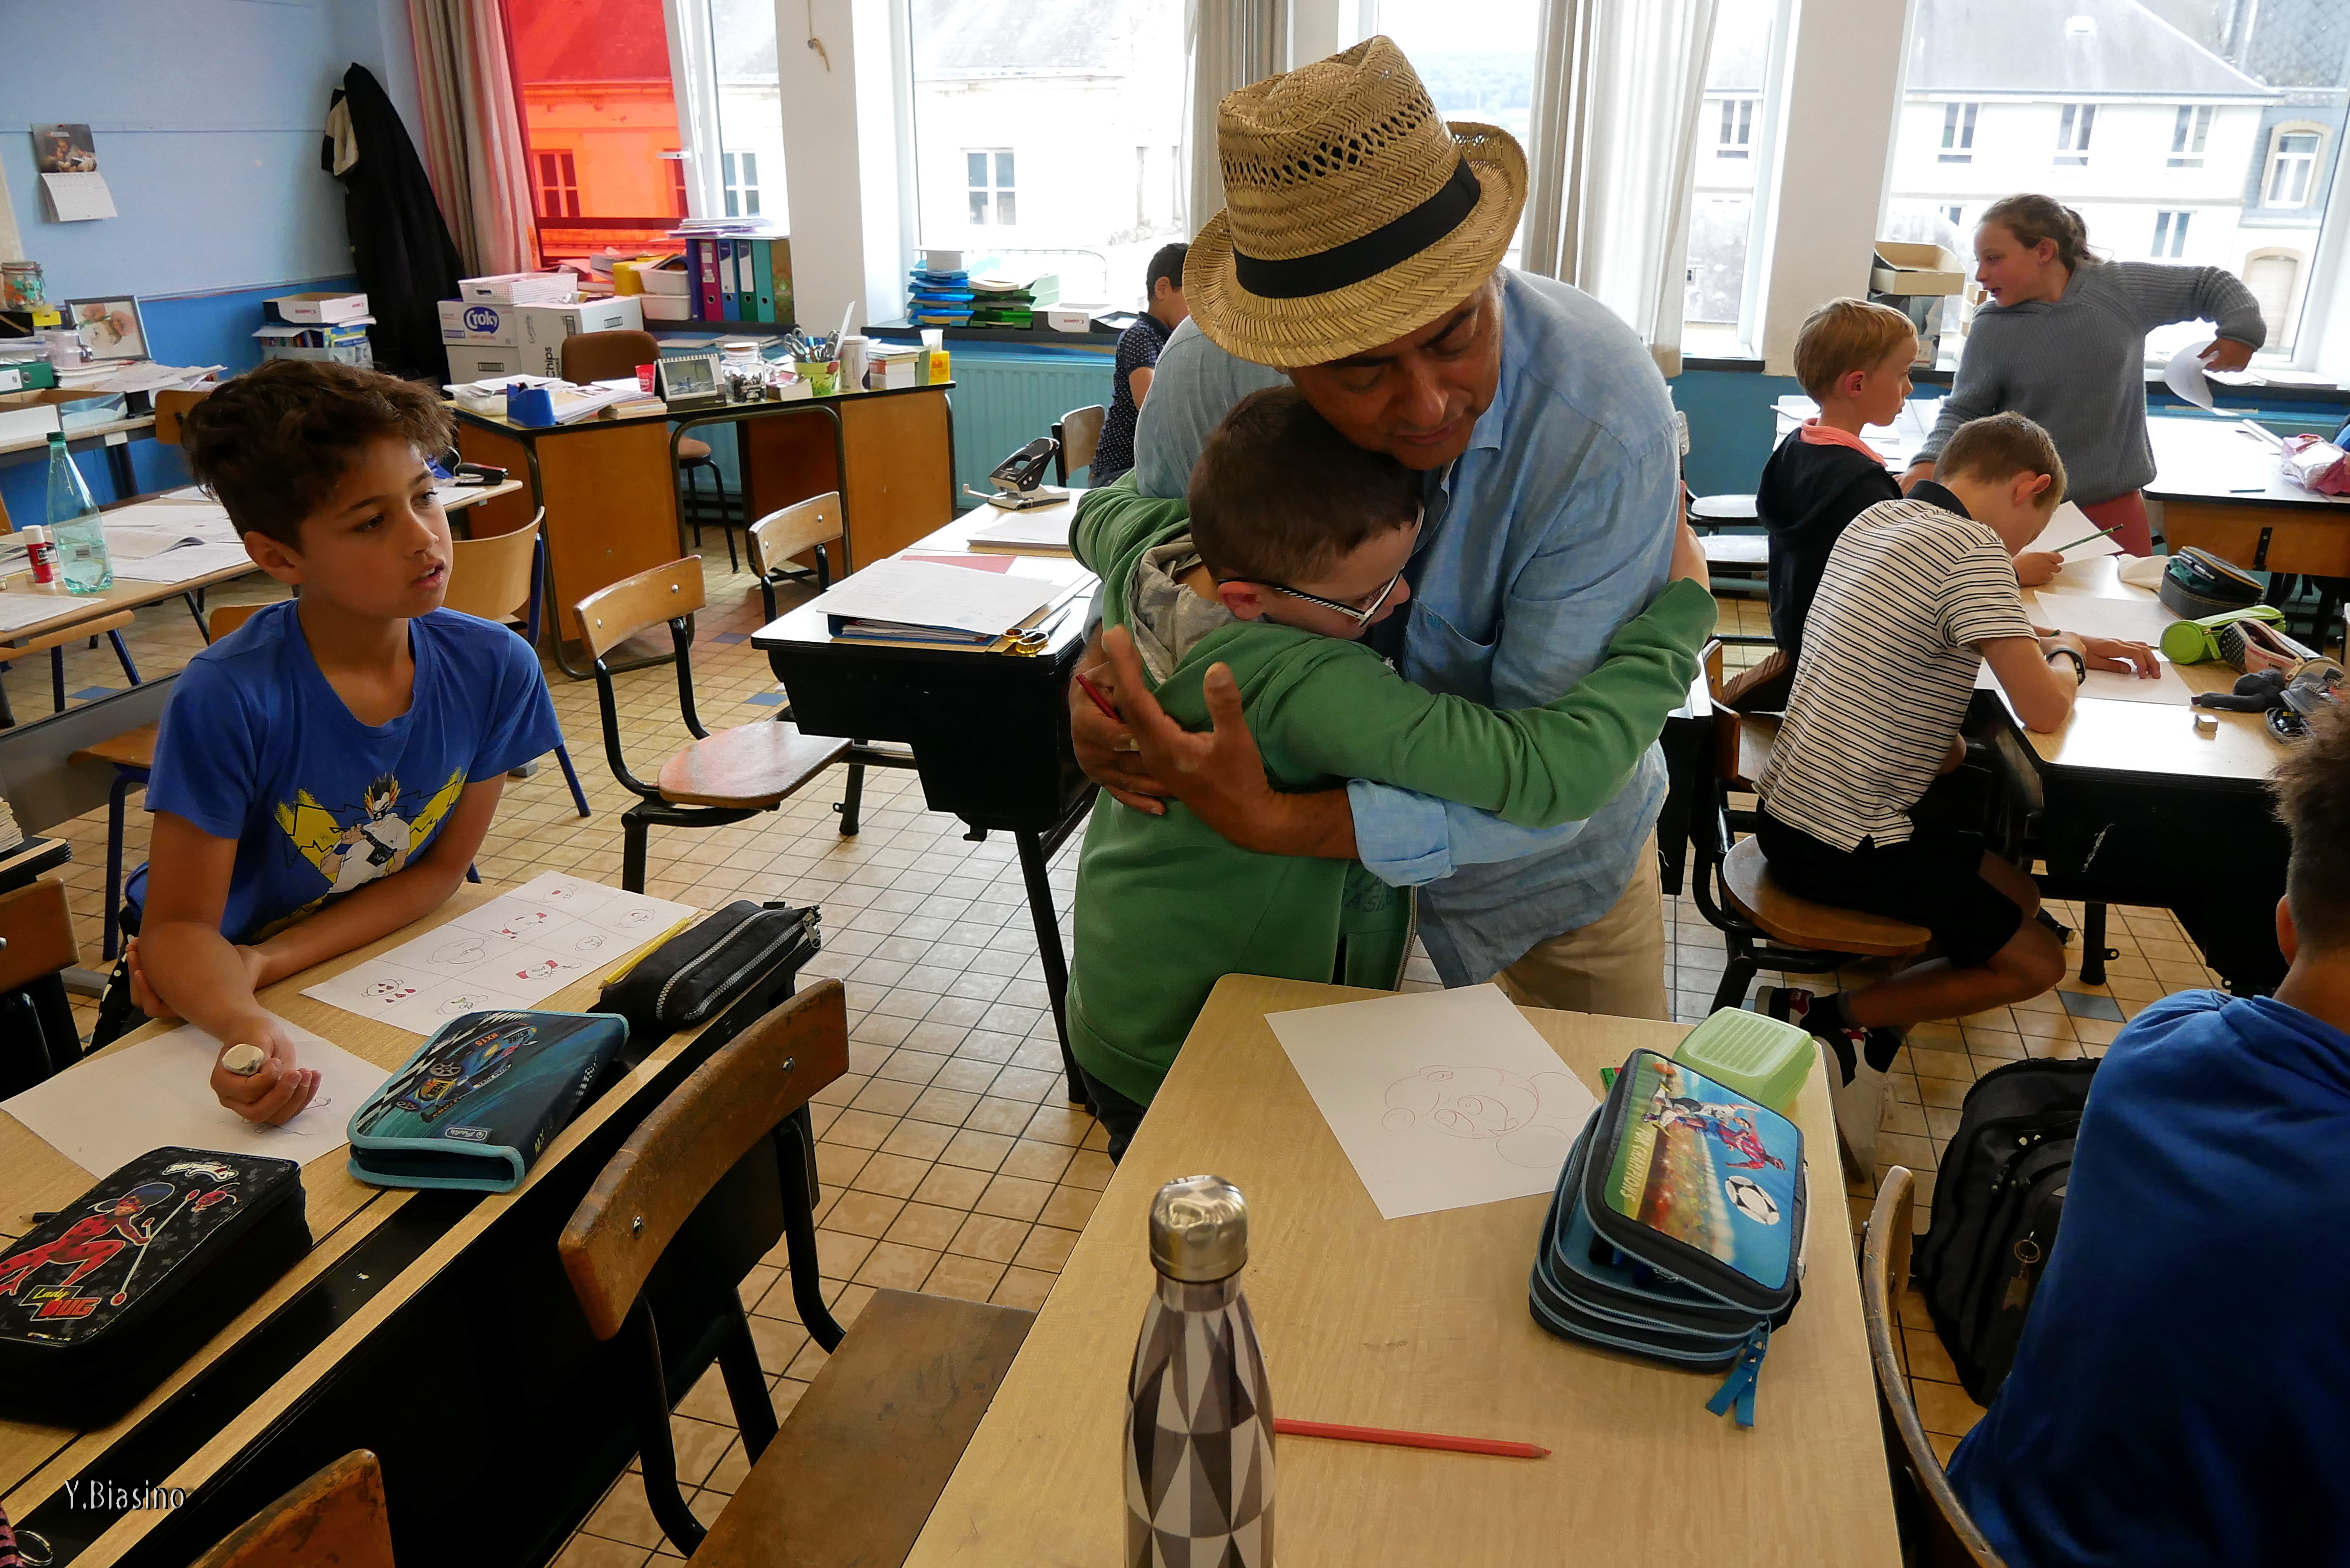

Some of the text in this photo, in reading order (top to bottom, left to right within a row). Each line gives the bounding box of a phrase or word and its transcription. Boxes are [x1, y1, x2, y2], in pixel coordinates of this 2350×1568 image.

[466, 310, 497, 330] Croky
[545, 346, 556, 378] Chips
[475, 1032, 499, 1047] MX15
[1620, 1126, 1652, 1202] FOR CHAMPIONS
[32, 1288, 71, 1301] Lady
